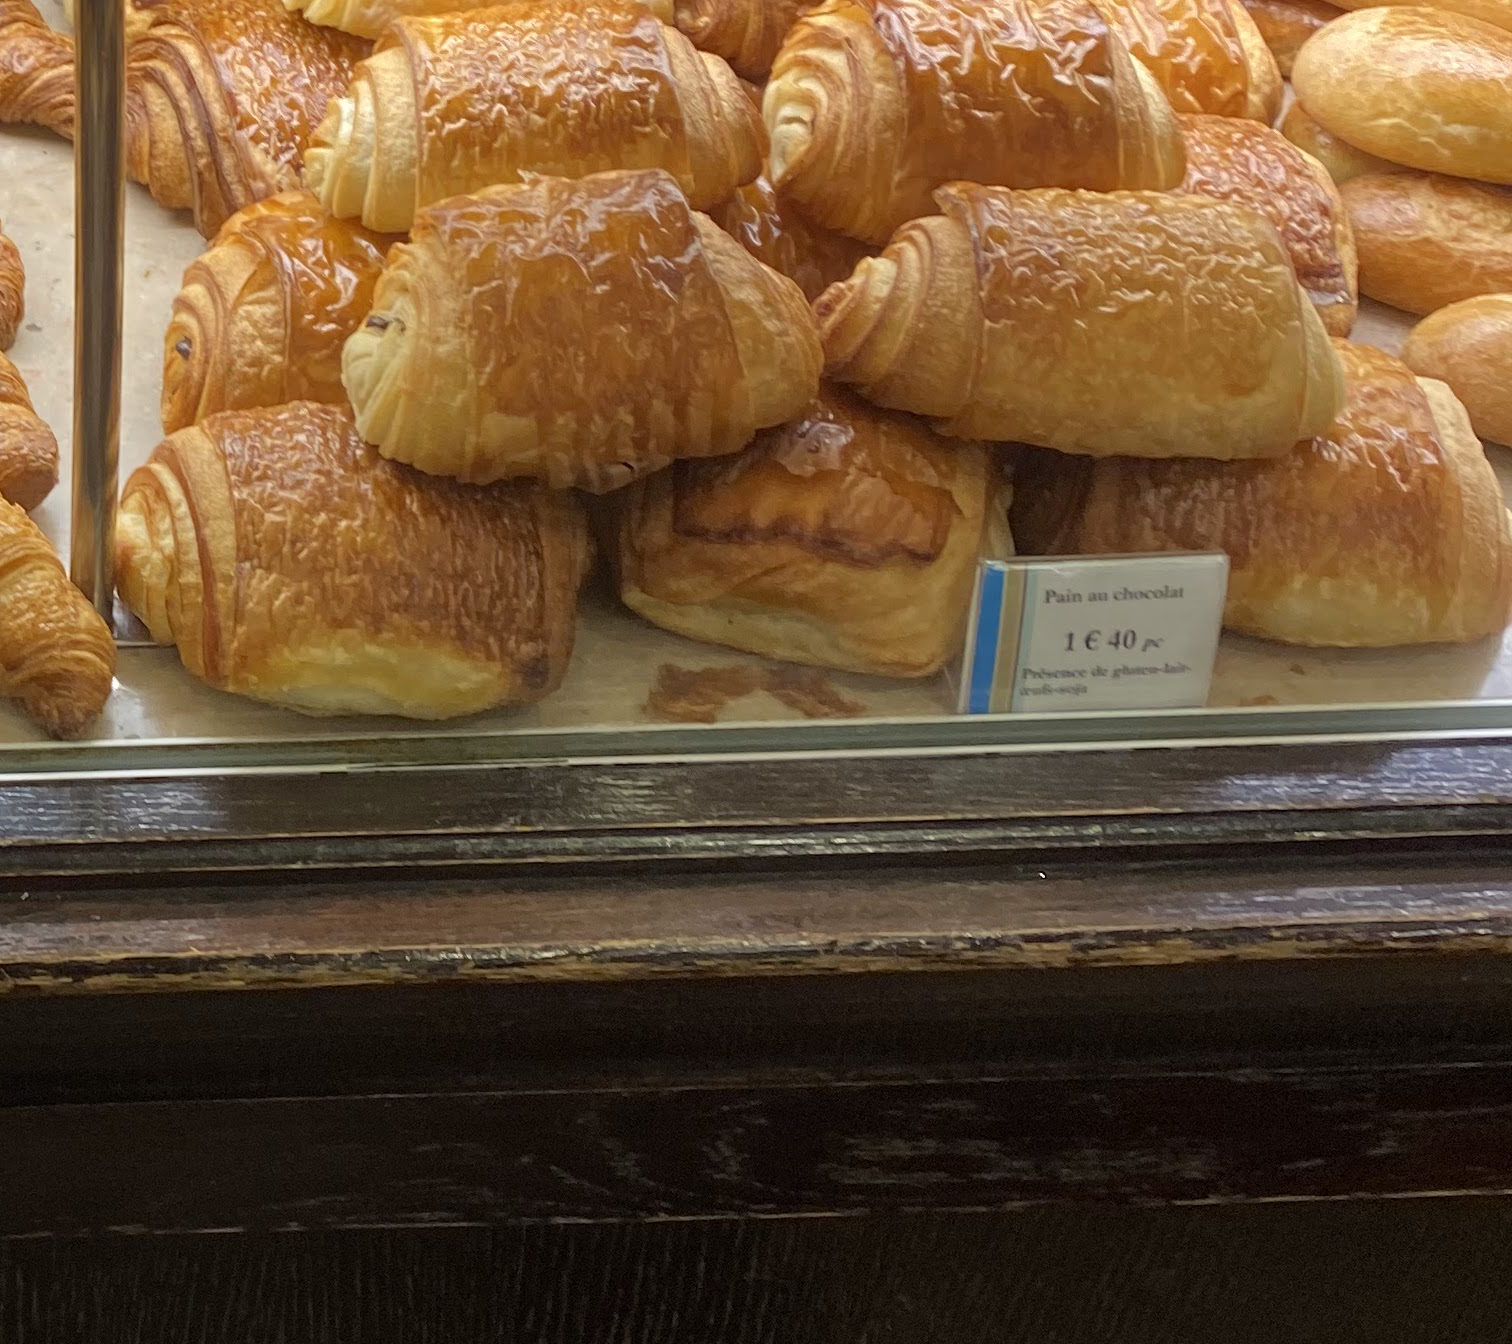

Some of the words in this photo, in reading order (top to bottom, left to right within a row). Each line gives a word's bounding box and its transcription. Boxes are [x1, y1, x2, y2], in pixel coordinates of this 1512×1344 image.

[1044, 588, 1083, 604] Pain
[1087, 590, 1108, 603] au
[1112, 583, 1185, 602] chocolat
[1022, 668, 1088, 680] Présence
[1090, 665, 1109, 677] de
